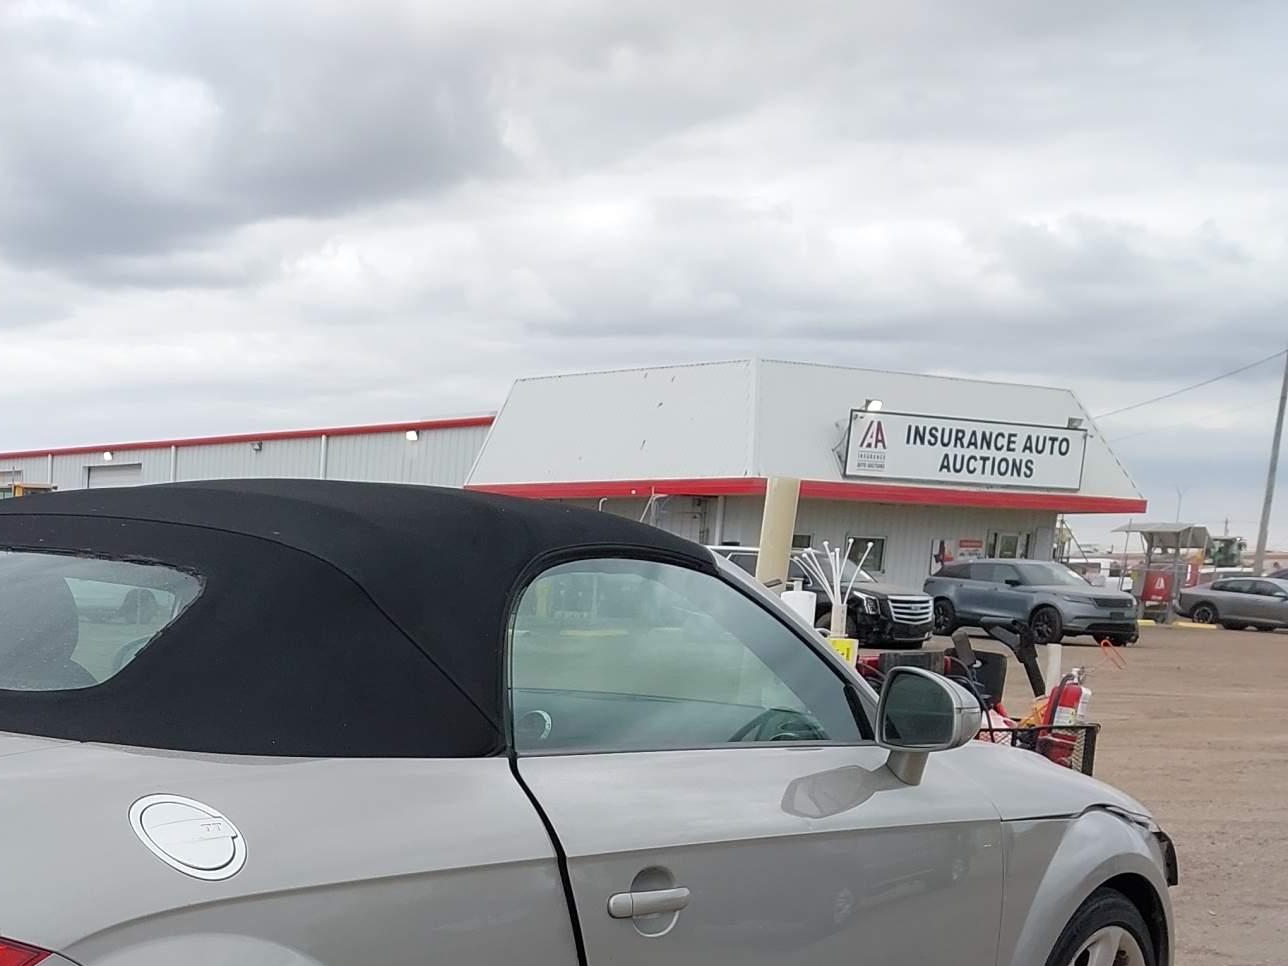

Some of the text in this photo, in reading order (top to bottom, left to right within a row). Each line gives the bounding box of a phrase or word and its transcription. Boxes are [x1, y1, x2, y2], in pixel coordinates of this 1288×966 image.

[906, 424, 1071, 457] INSURANCE AUTO
[939, 453, 1034, 479] AUCTIONS
